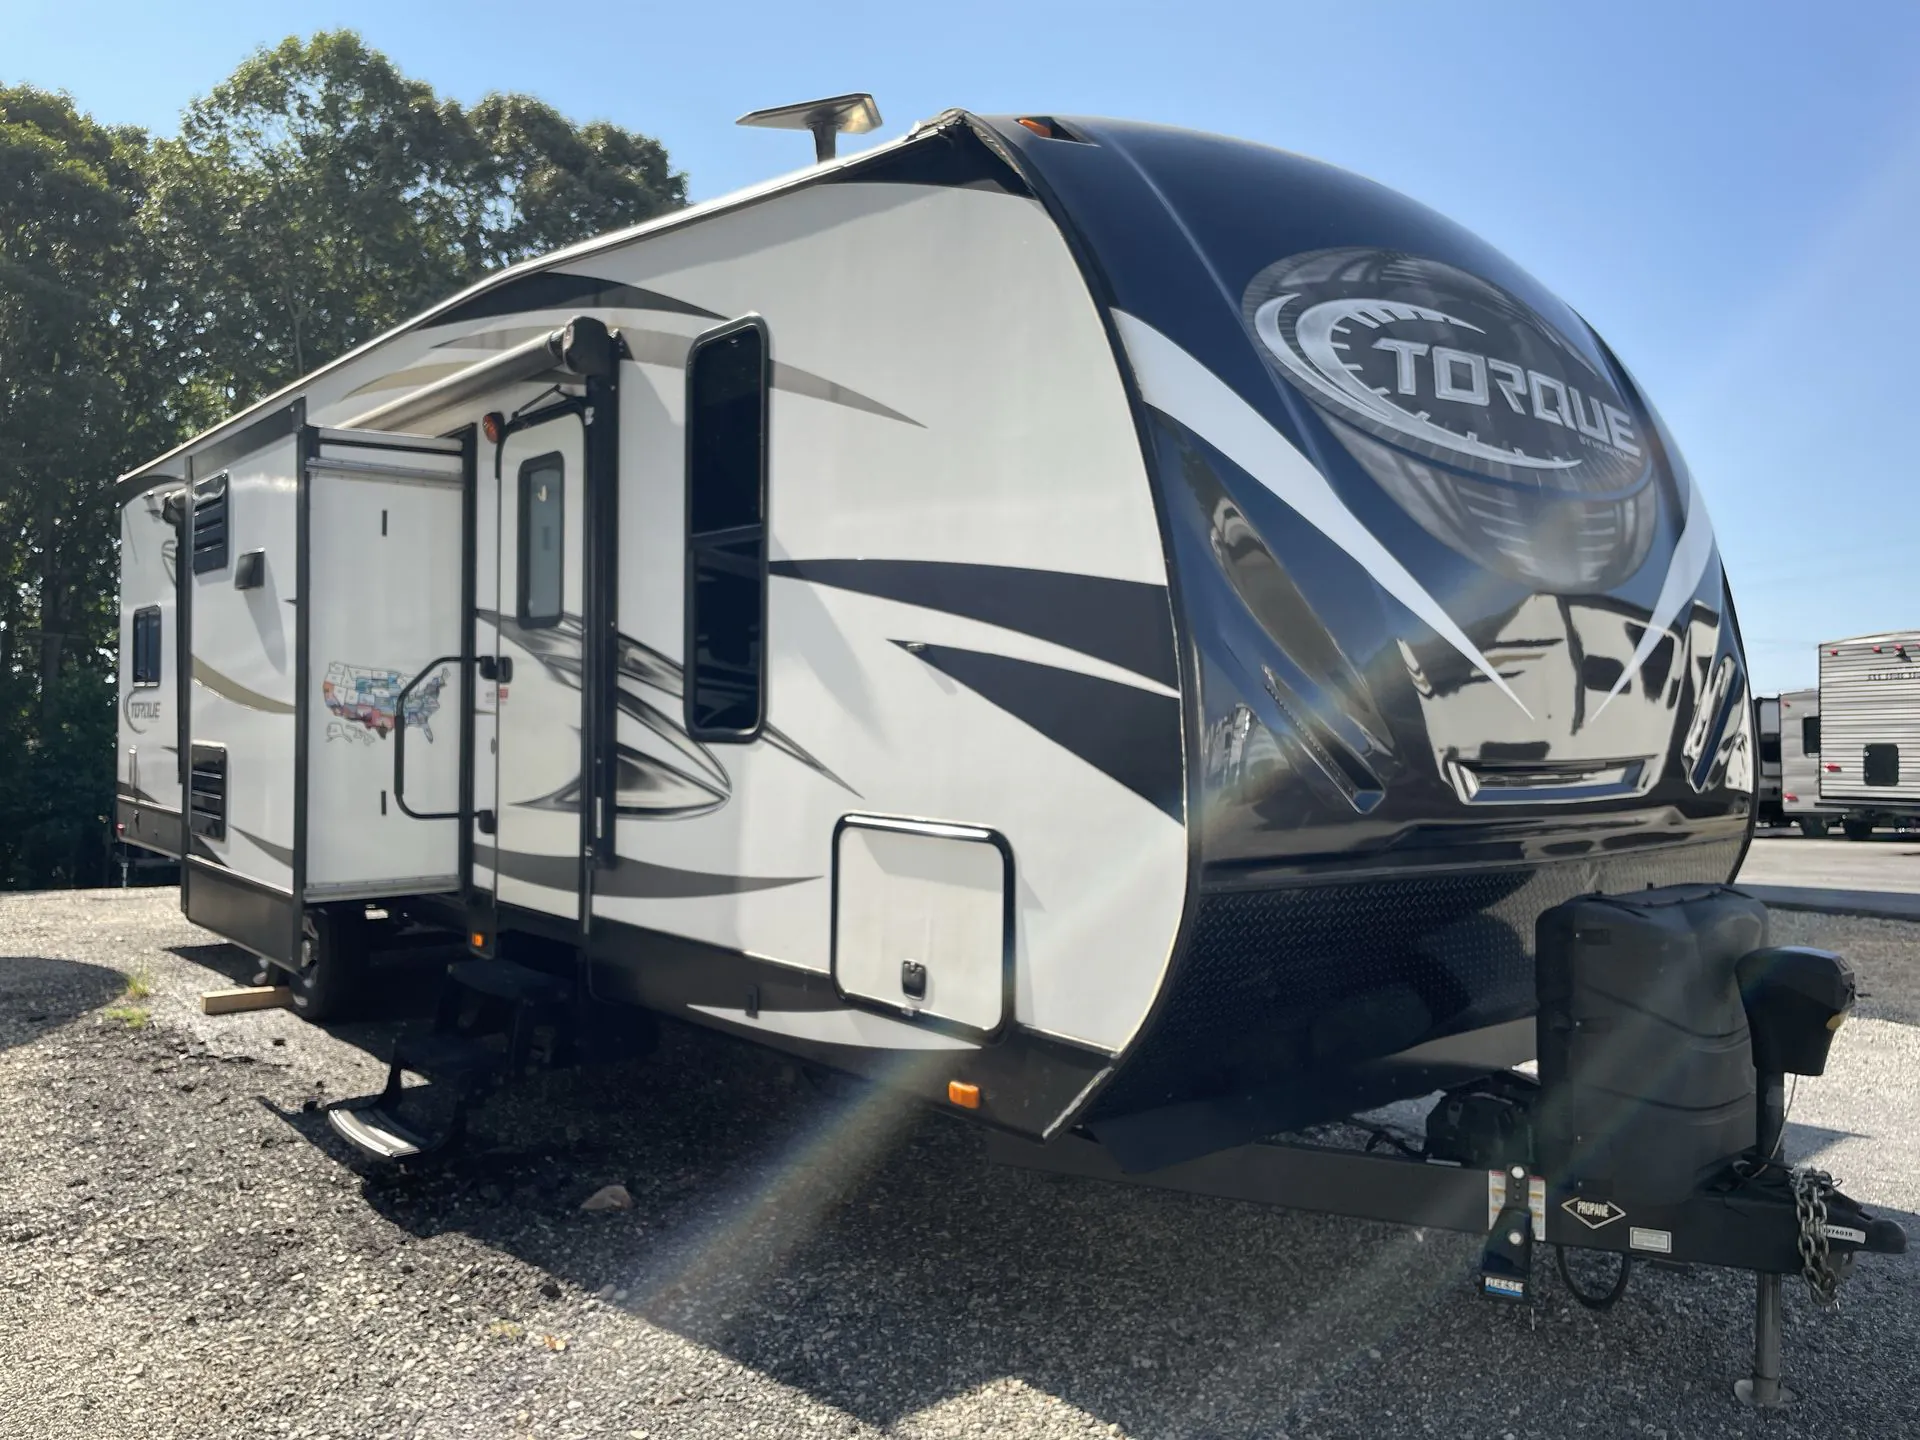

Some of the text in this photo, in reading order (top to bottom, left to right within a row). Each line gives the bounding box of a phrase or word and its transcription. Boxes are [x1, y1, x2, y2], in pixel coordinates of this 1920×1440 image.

[1372, 337, 1641, 458] TORQUE
[1577, 1201, 1609, 1217] PROPANE
[1485, 1276, 1523, 1293] REESE
